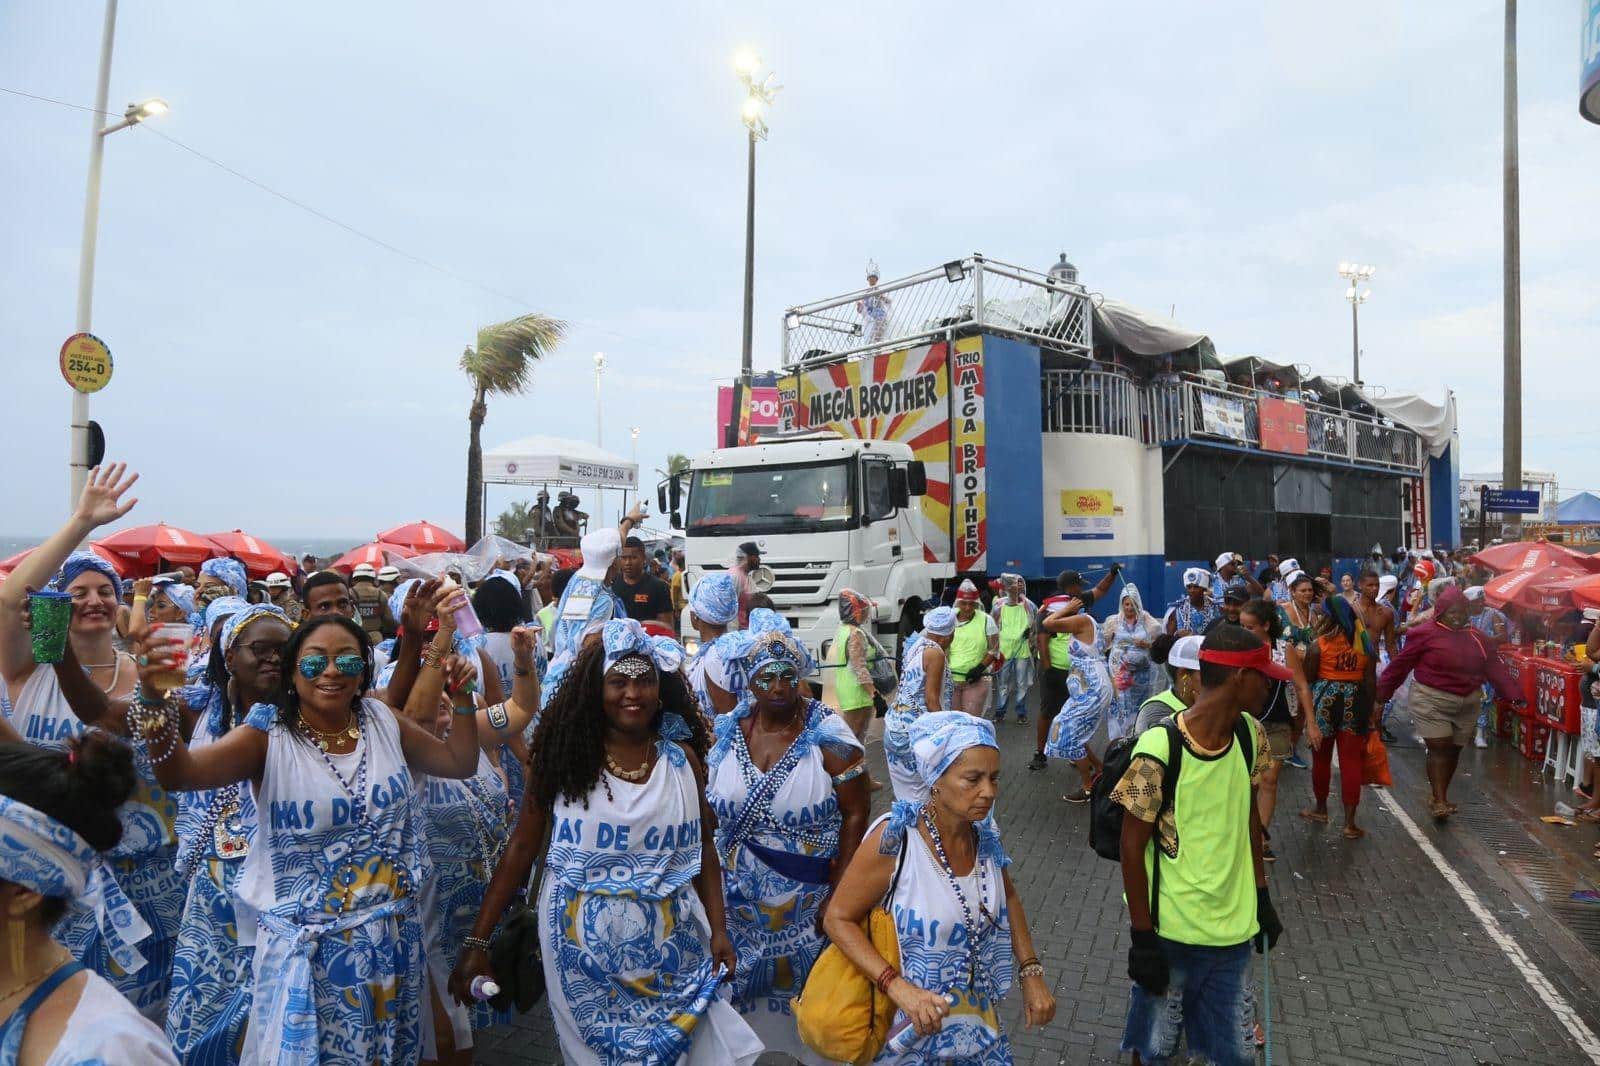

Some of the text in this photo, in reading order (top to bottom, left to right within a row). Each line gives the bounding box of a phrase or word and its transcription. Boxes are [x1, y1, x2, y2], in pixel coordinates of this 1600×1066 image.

[69, 359, 105, 375] 254-D
[956, 351, 980, 367] TRIO
[808, 373, 938, 427] MEGA BROTHER
[960, 369, 978, 434] MEGA
[963, 443, 979, 556] BROTHER
[596, 822, 631, 851] DE
